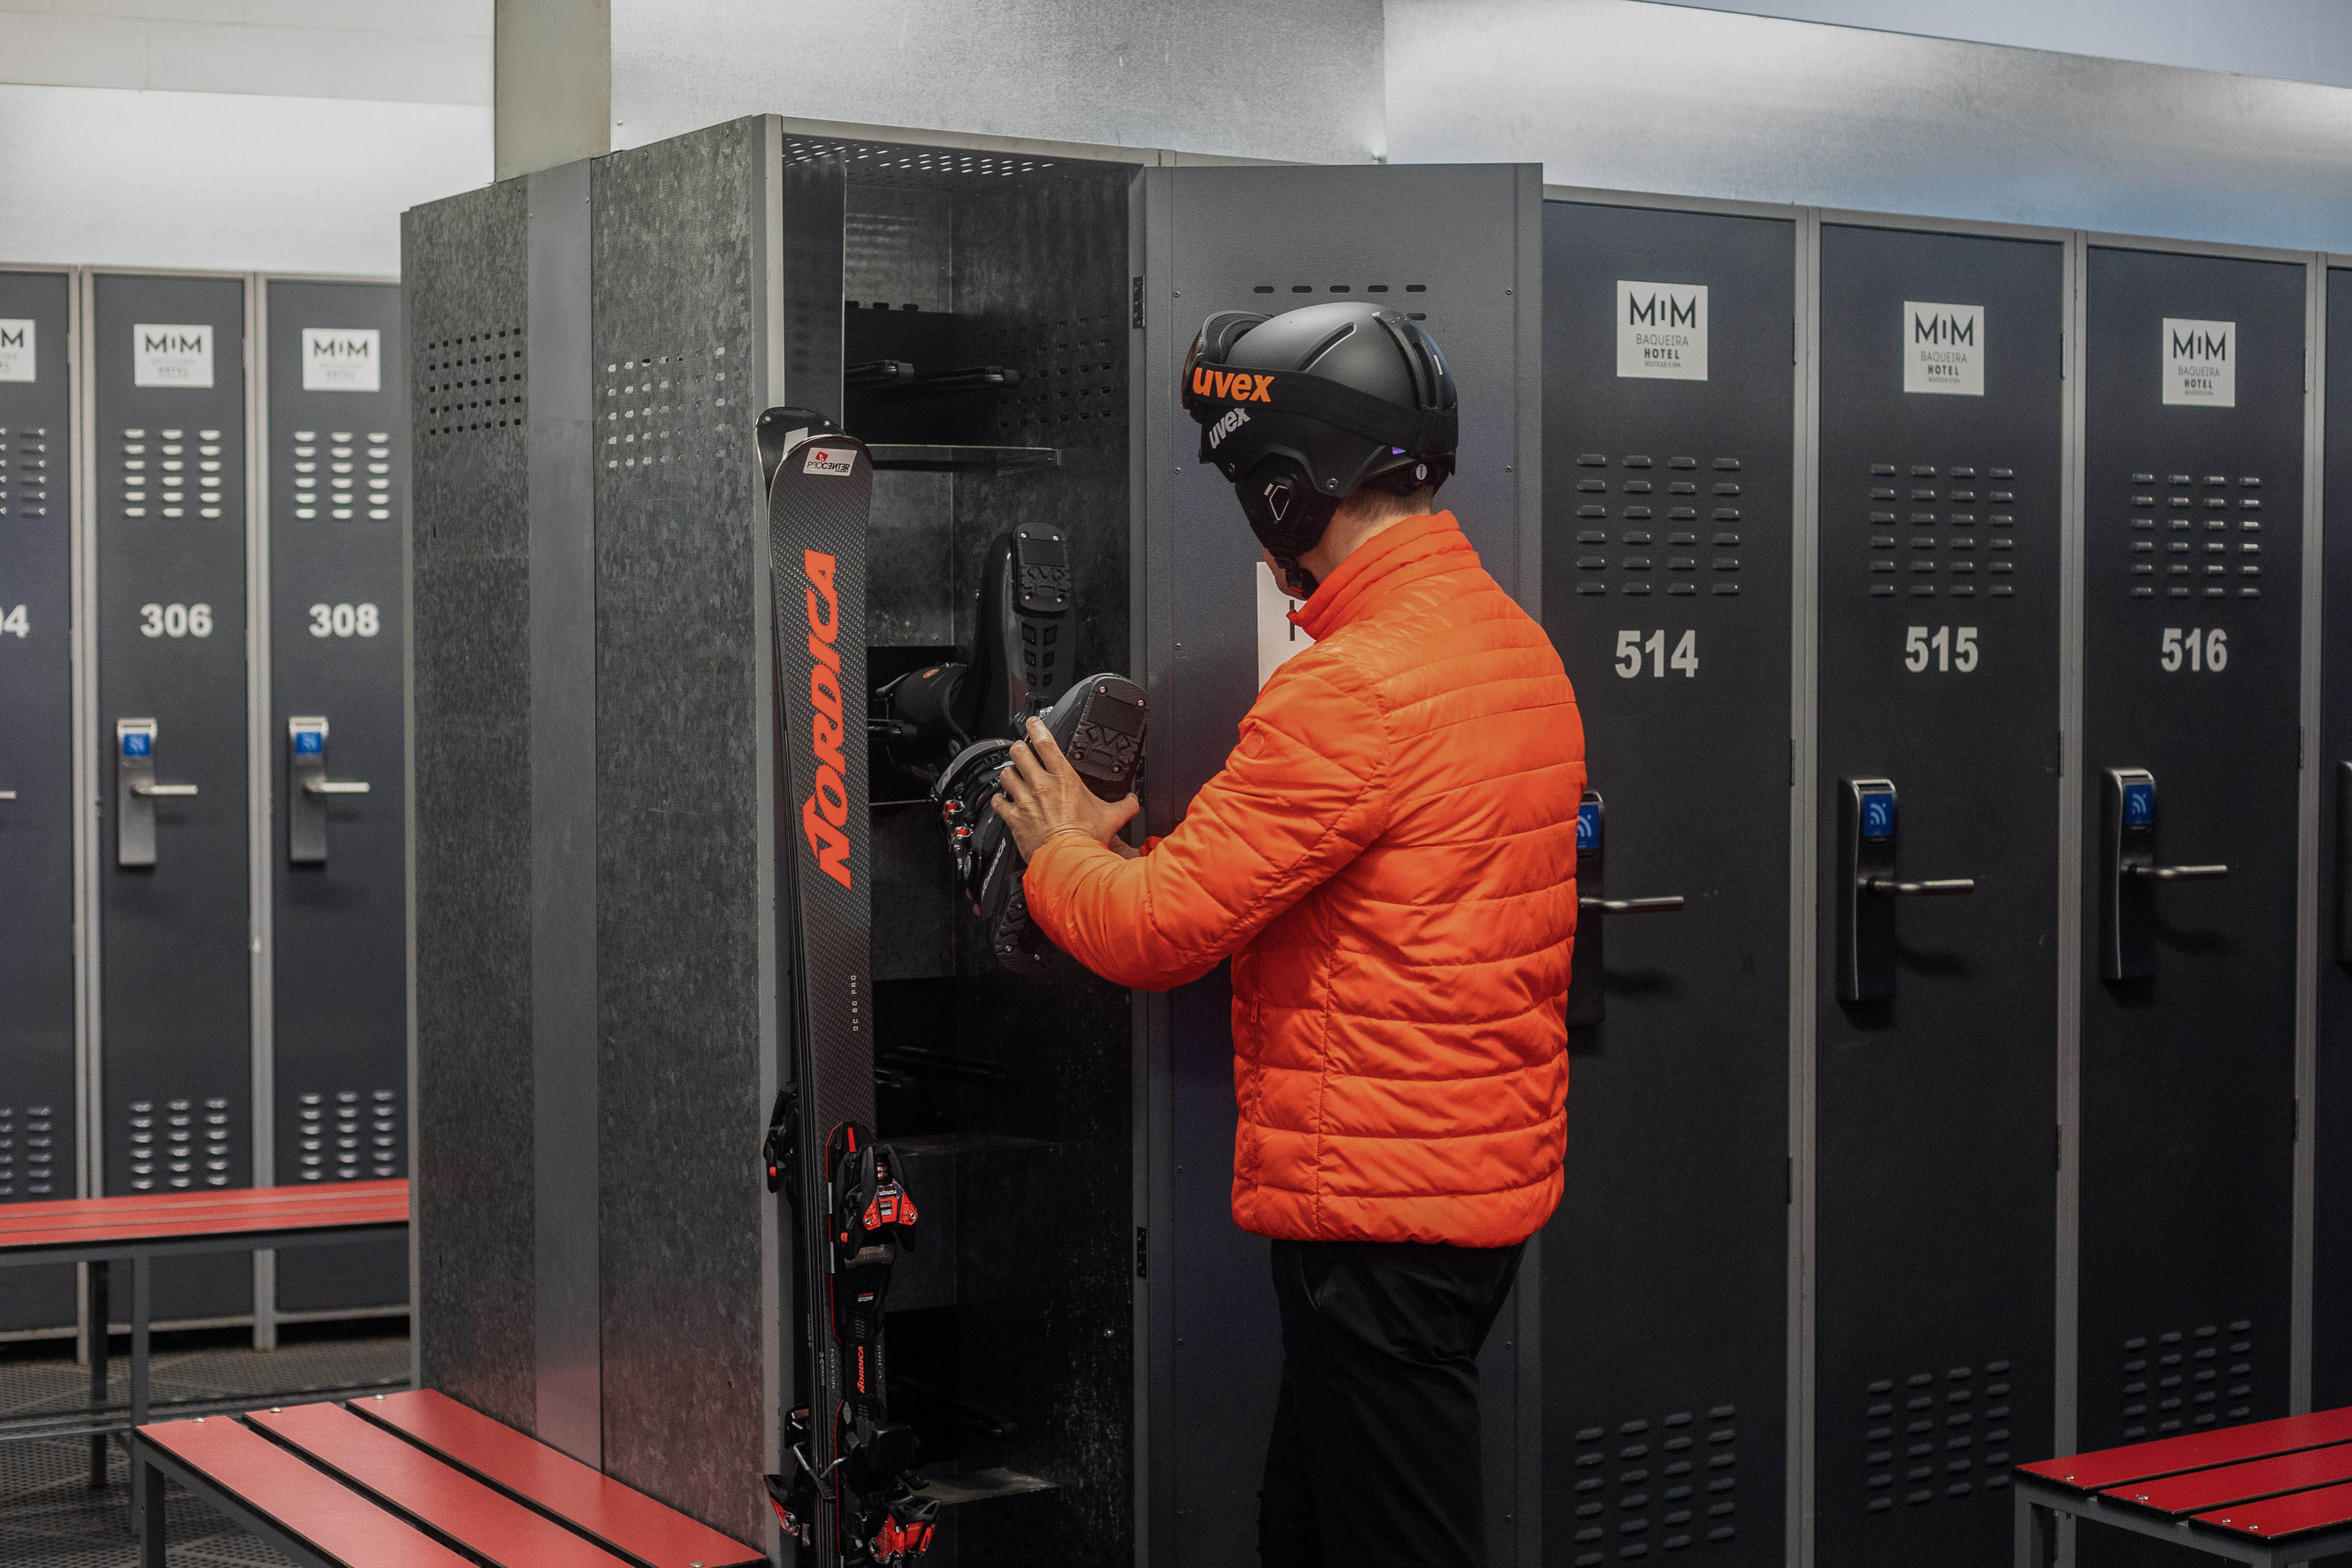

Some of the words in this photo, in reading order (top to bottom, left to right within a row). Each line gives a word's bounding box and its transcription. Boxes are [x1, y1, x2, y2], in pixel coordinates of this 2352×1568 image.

[1629, 290, 1696, 328] MIM
[145, 334, 201, 353] MIM
[1637, 333, 1689, 346] BAQUEIRA
[1915, 311, 1974, 346] MIM
[2173, 328, 2226, 361] MIM
[313, 339, 368, 357] MIM
[1644, 348, 1679, 359] HOTEL
[1921, 351, 1967, 363] BAQUEIRA
[1192, 367, 1275, 403] uvex
[1928, 364, 1959, 376] HOTEL
[2178, 365, 2220, 377] BAQUEIRA
[2185, 378, 2213, 389] HOTEL
[1209, 407, 1251, 449] uvex
[141, 603, 213, 638] 306
[308, 603, 380, 638] 308
[1615, 629, 1698, 679] 514
[1905, 626, 1979, 673] 515
[2161, 628, 2228, 672] 516
[802, 549, 851, 890] NORDICA
